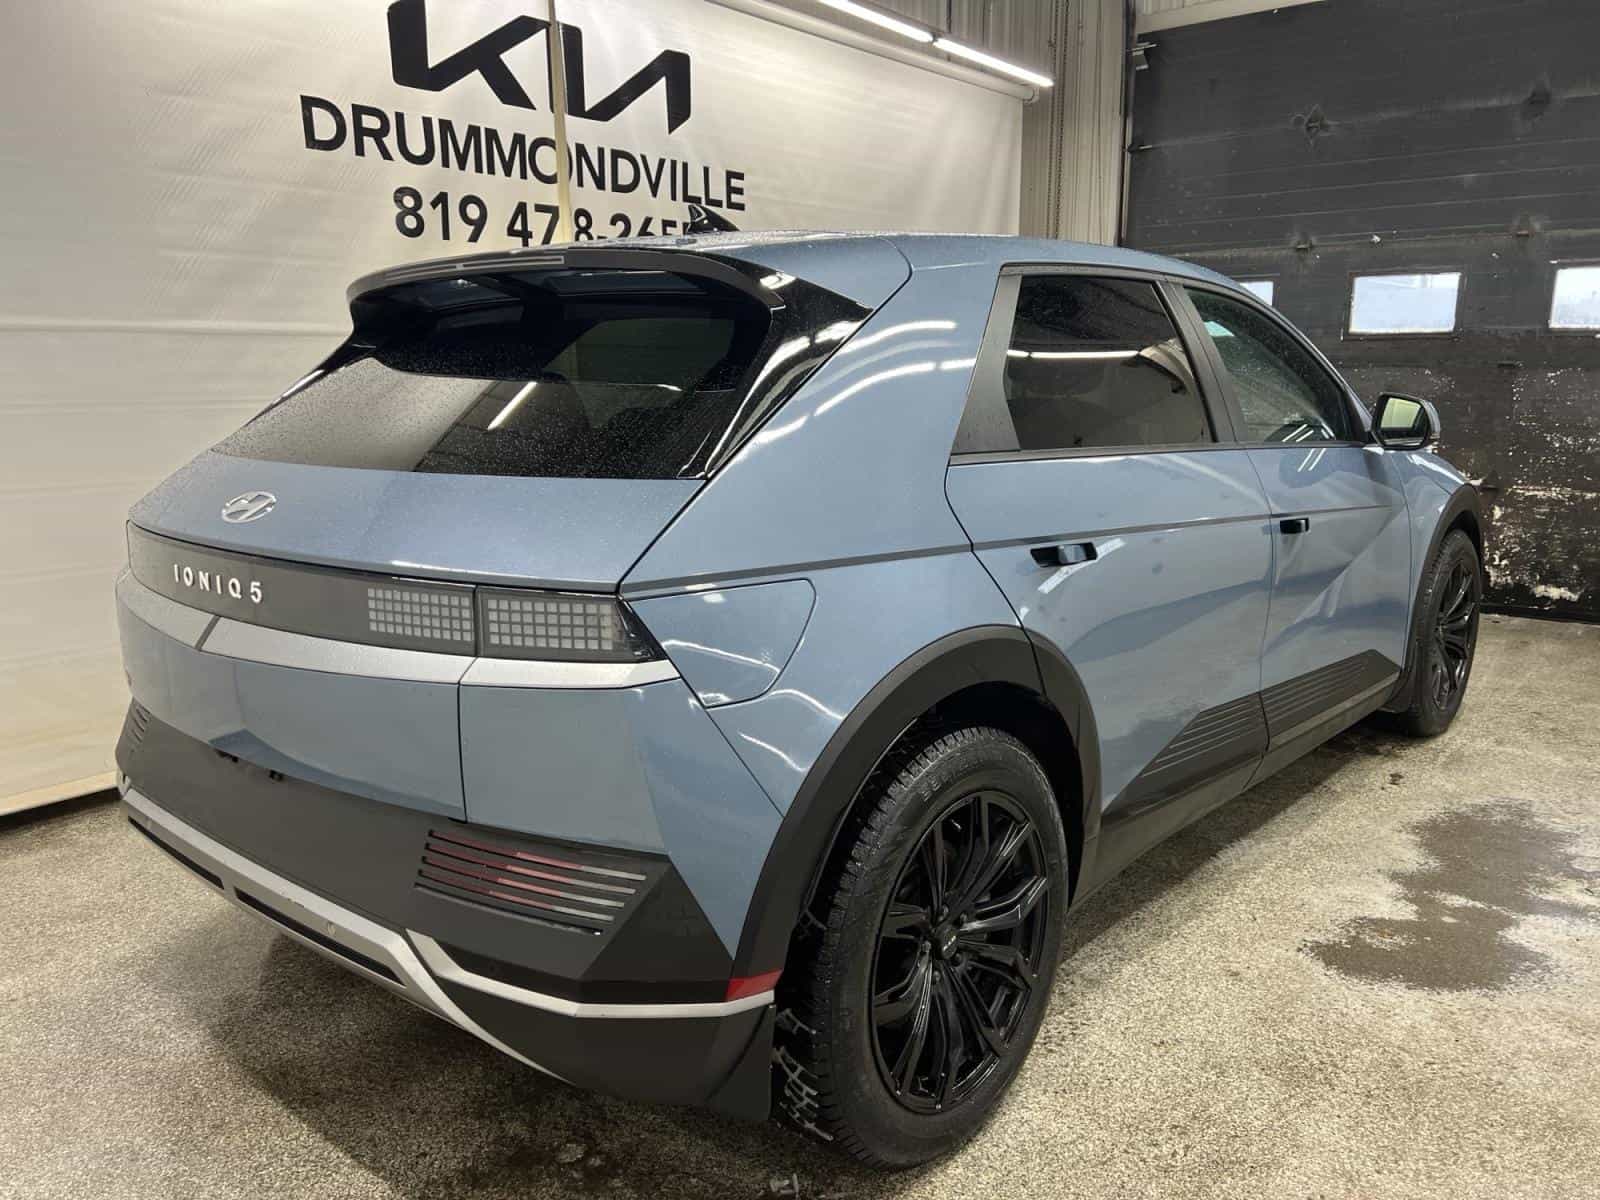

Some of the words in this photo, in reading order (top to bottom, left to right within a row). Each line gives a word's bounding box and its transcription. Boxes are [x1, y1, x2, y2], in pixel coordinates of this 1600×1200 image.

[300, 95, 746, 211] DRUMMONDVILLE
[393, 187, 487, 243] 819
[174, 564, 242, 599] IONIQ
[250, 581, 262, 604] 5
